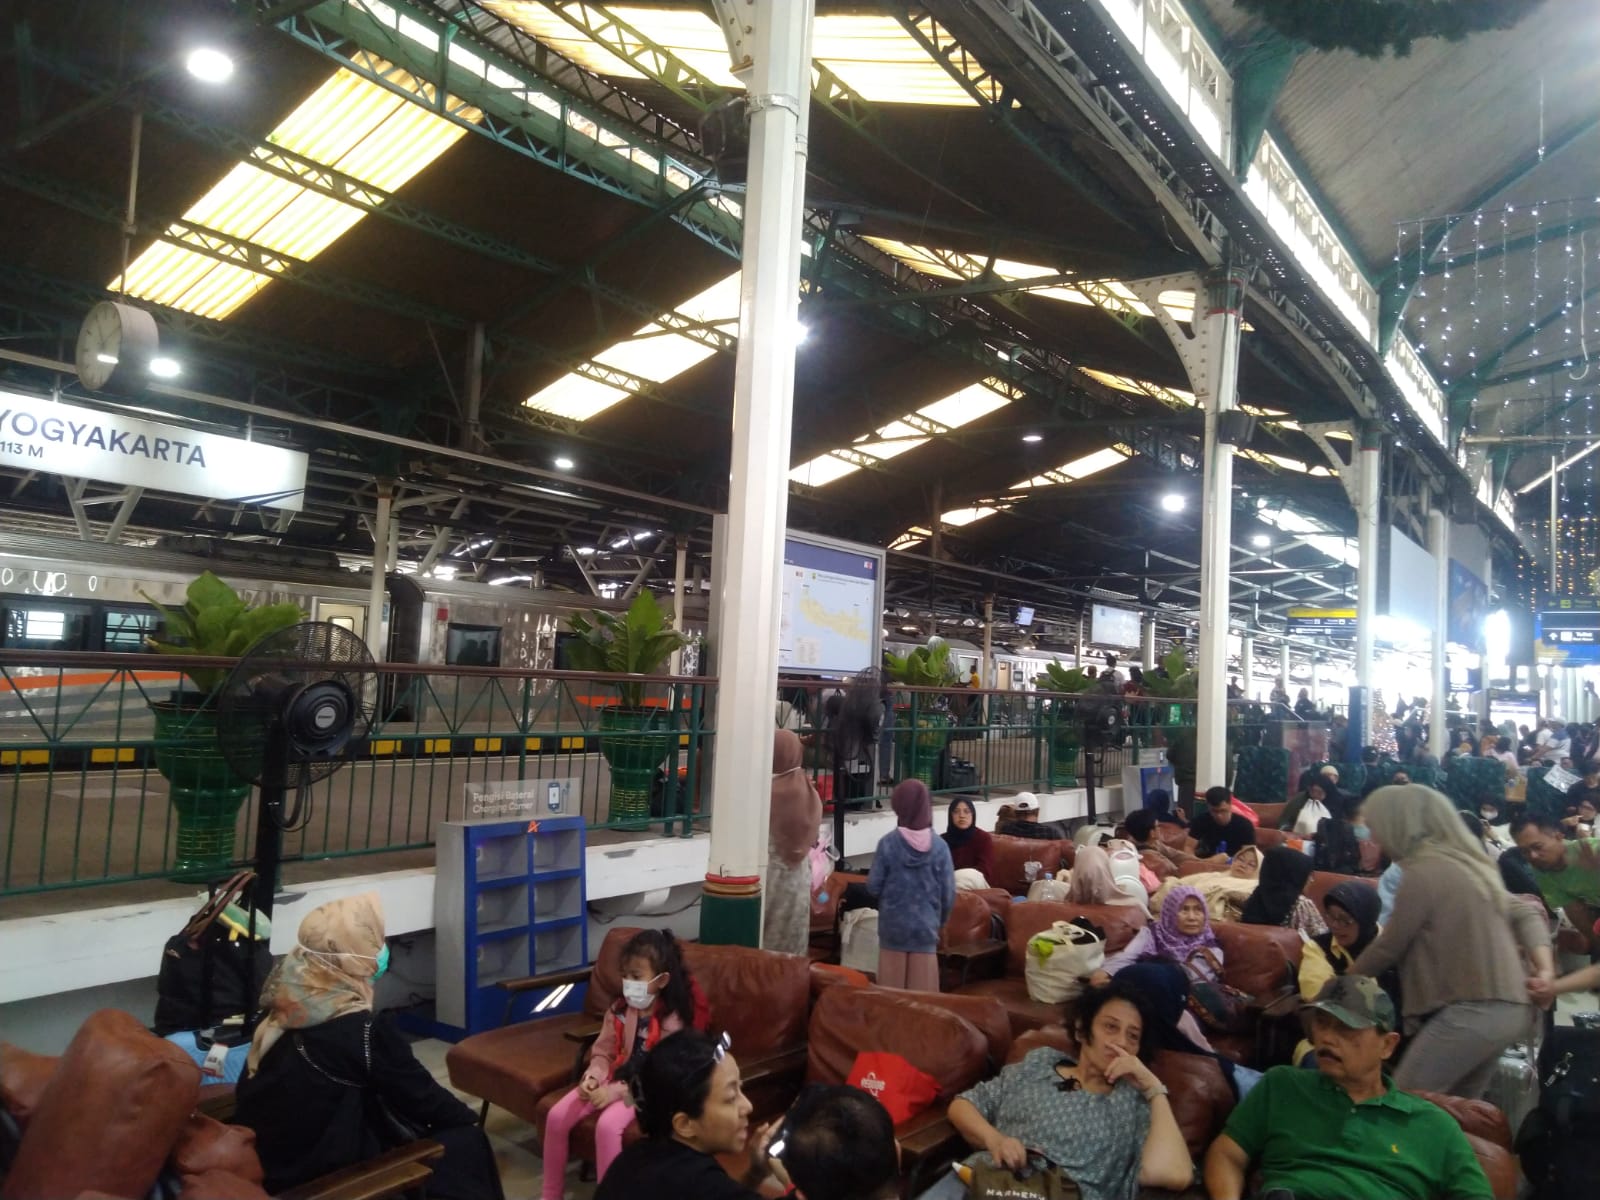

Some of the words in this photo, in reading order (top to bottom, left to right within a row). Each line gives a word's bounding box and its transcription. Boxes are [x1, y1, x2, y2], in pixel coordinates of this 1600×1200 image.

[0, 408, 206, 468] YOGYAKARTA
[27, 444, 44, 458] M
[508, 801, 533, 810] Corner
